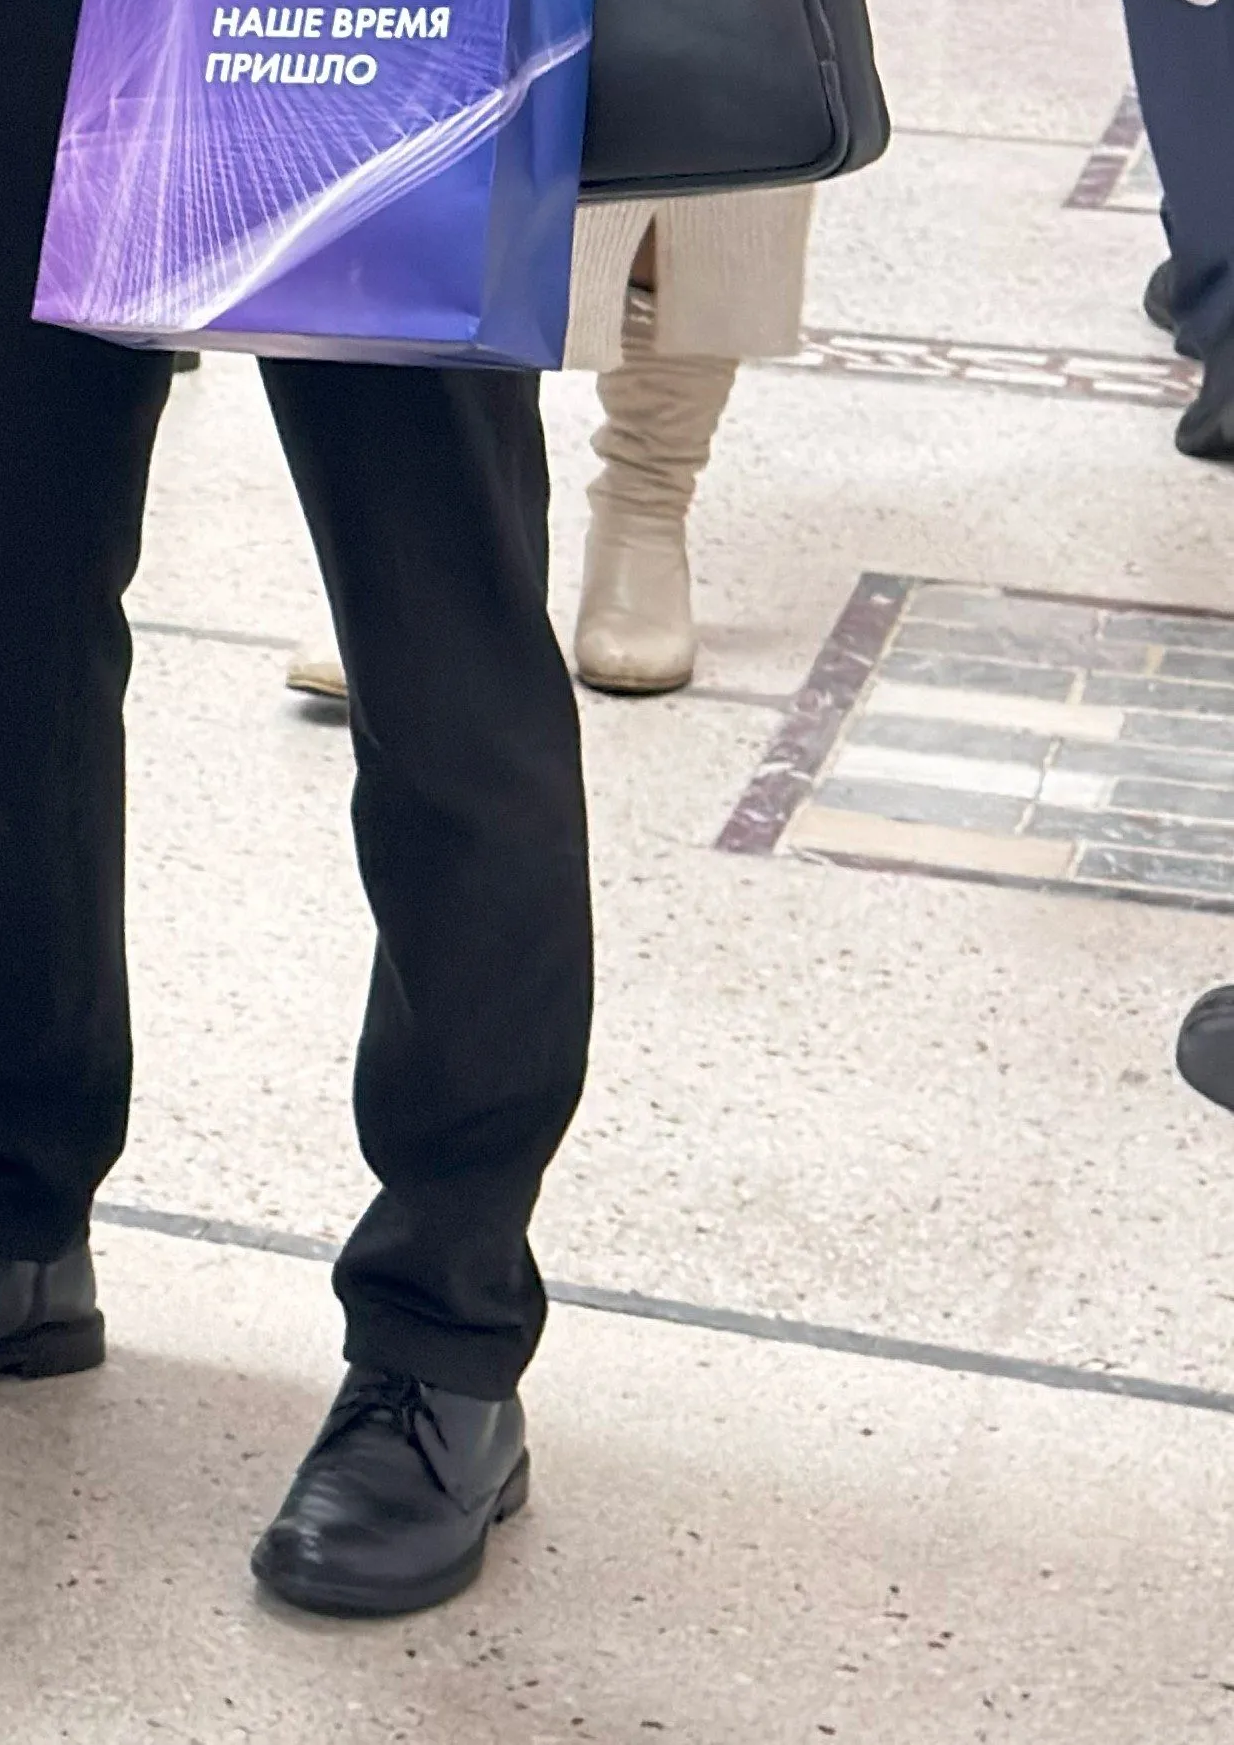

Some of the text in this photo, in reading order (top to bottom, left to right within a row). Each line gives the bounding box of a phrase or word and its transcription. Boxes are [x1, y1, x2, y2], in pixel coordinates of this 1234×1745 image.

[212, 6, 451, 40] НАШЕ ВРЕМЯ
[205, 53, 378, 85] ПРИШЛО
